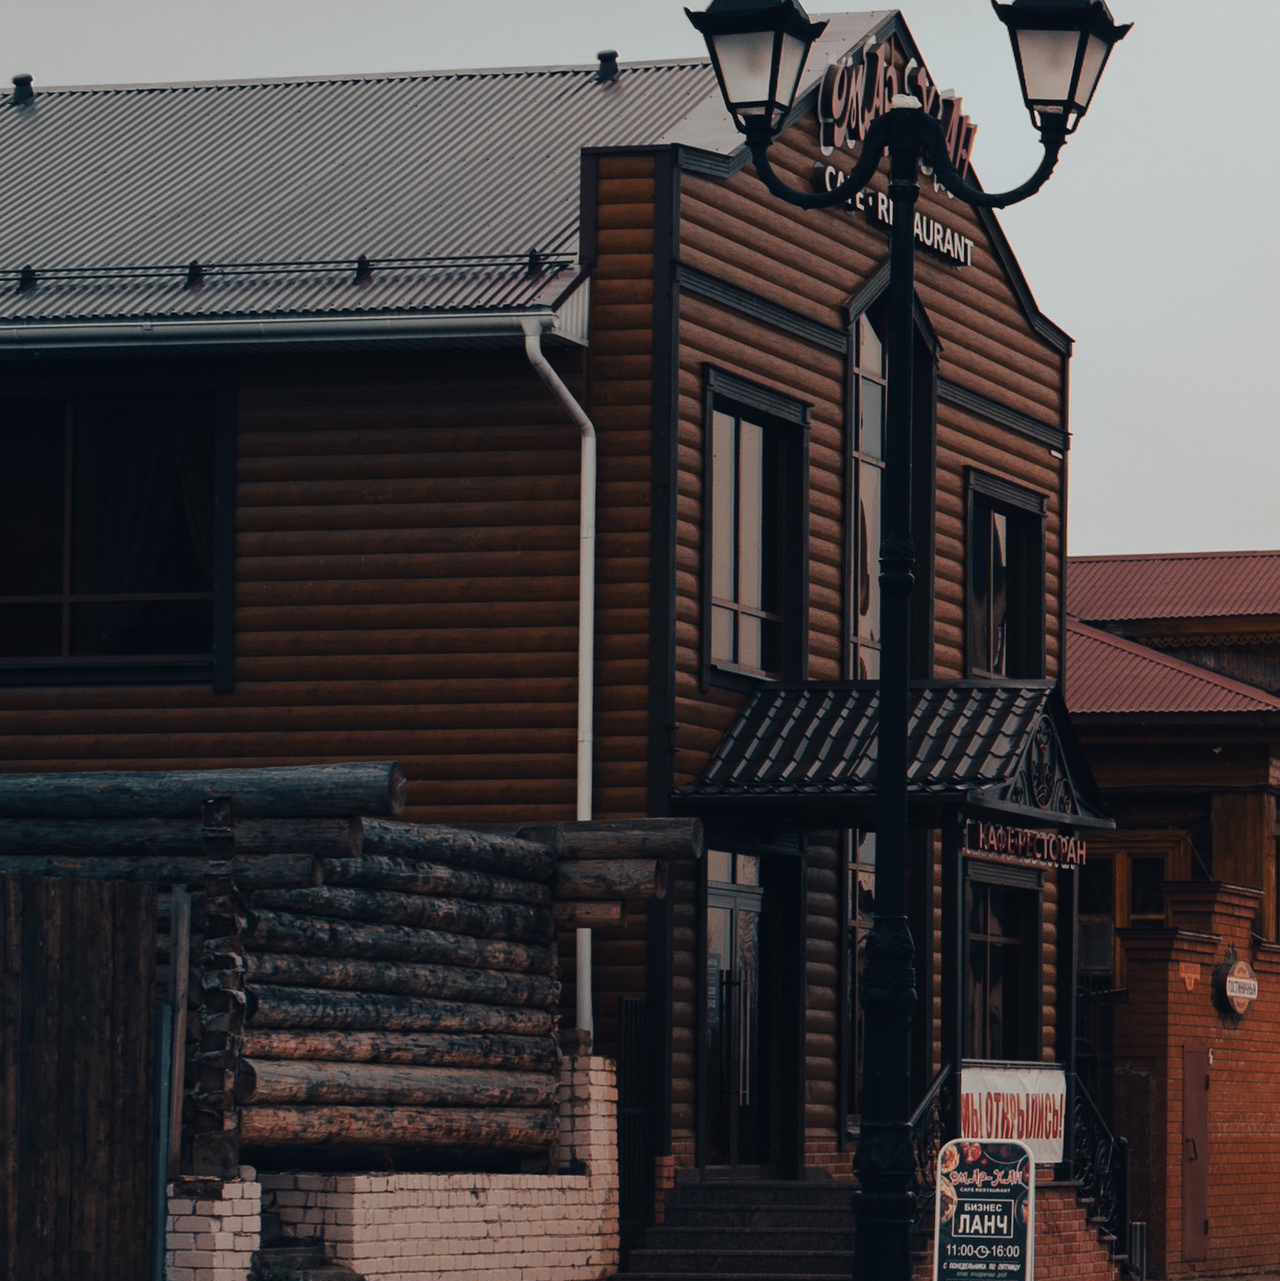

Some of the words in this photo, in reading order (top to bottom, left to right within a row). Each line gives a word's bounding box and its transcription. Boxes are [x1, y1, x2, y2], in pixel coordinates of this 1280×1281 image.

[878, 192, 974, 267] RAURANT
[961, 1092, 983, 1138] МЫ
[986, 1091, 1064, 1139] ОТКРЫЛИСЬ!
[964, 1203, 1003, 1212] БИЗНЕС
[958, 1214, 1008, 1234] ЛАНЧ
[946, 1244, 974, 1256] 11:00
[991, 1245, 1020, 1257] 16:00
[949, 1262, 987, 1270] ПОНЕДЕЛЬНИКА
